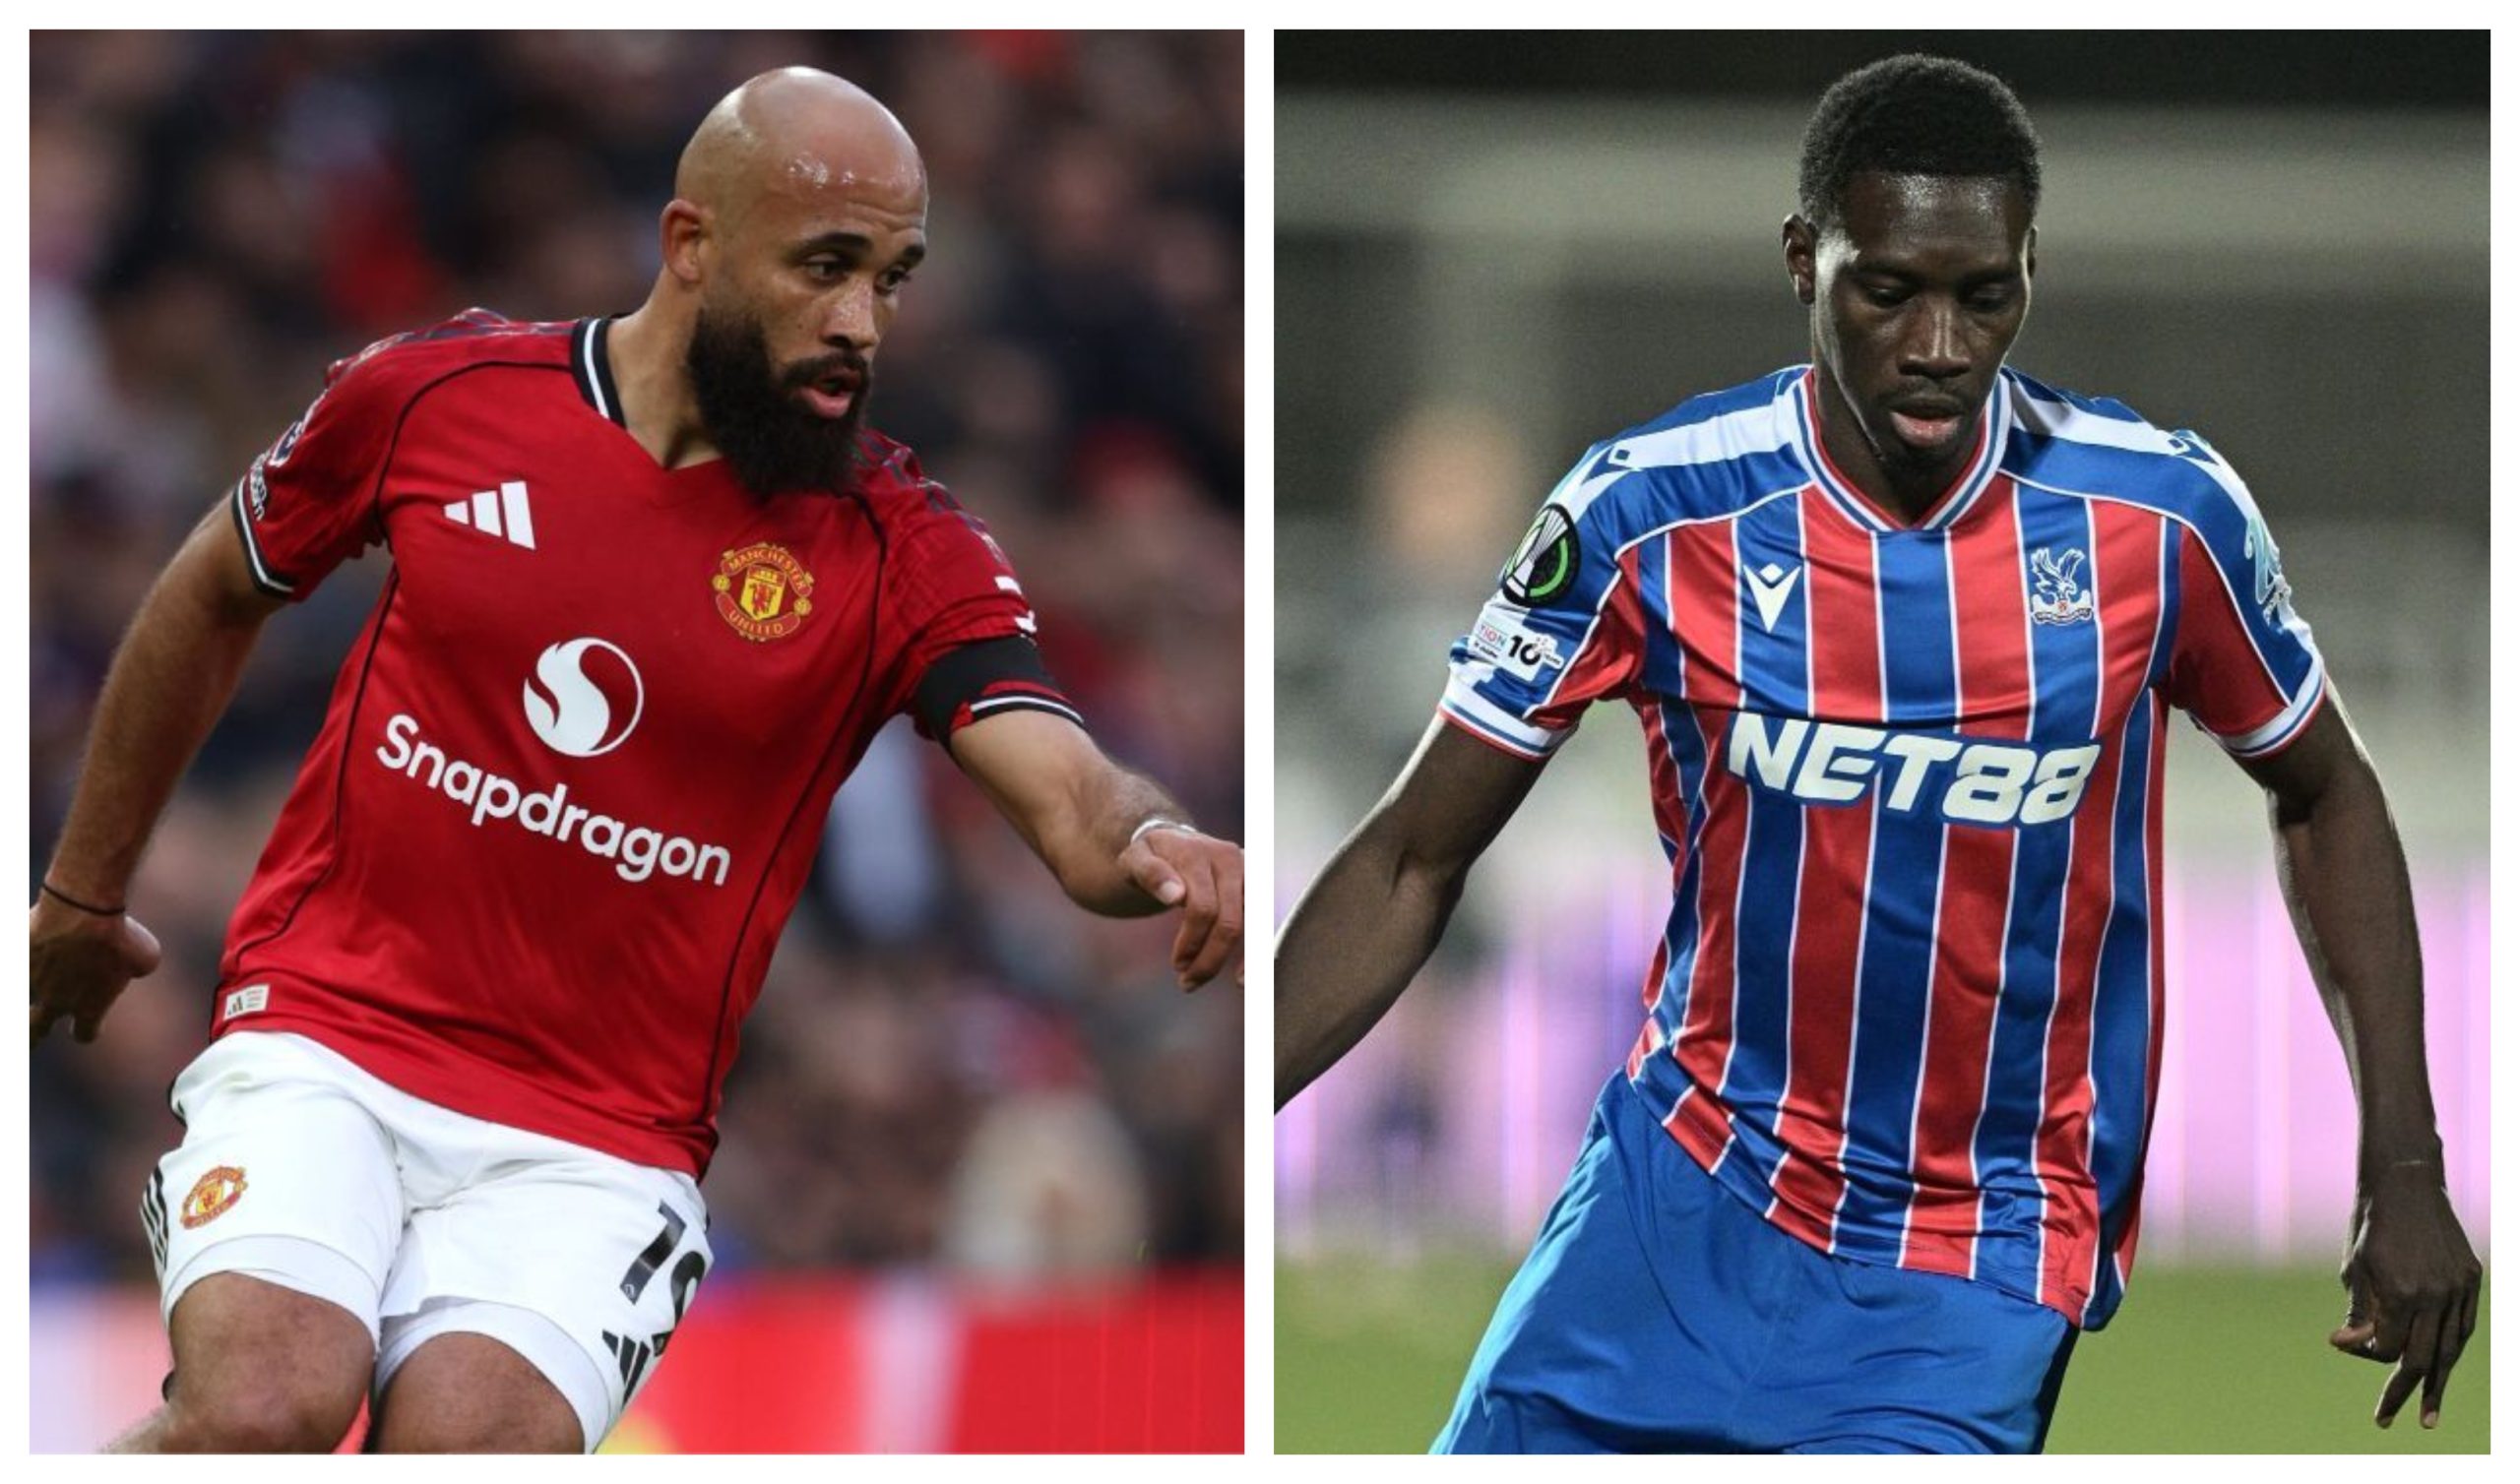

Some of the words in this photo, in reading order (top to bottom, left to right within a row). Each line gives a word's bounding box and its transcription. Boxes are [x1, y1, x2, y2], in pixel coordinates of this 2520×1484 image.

[728, 550, 806, 590] MANCHESTER
[728, 609, 784, 635] UNITED
[376, 713, 730, 886] Snapdragon
[1728, 711, 2101, 825] NET88
